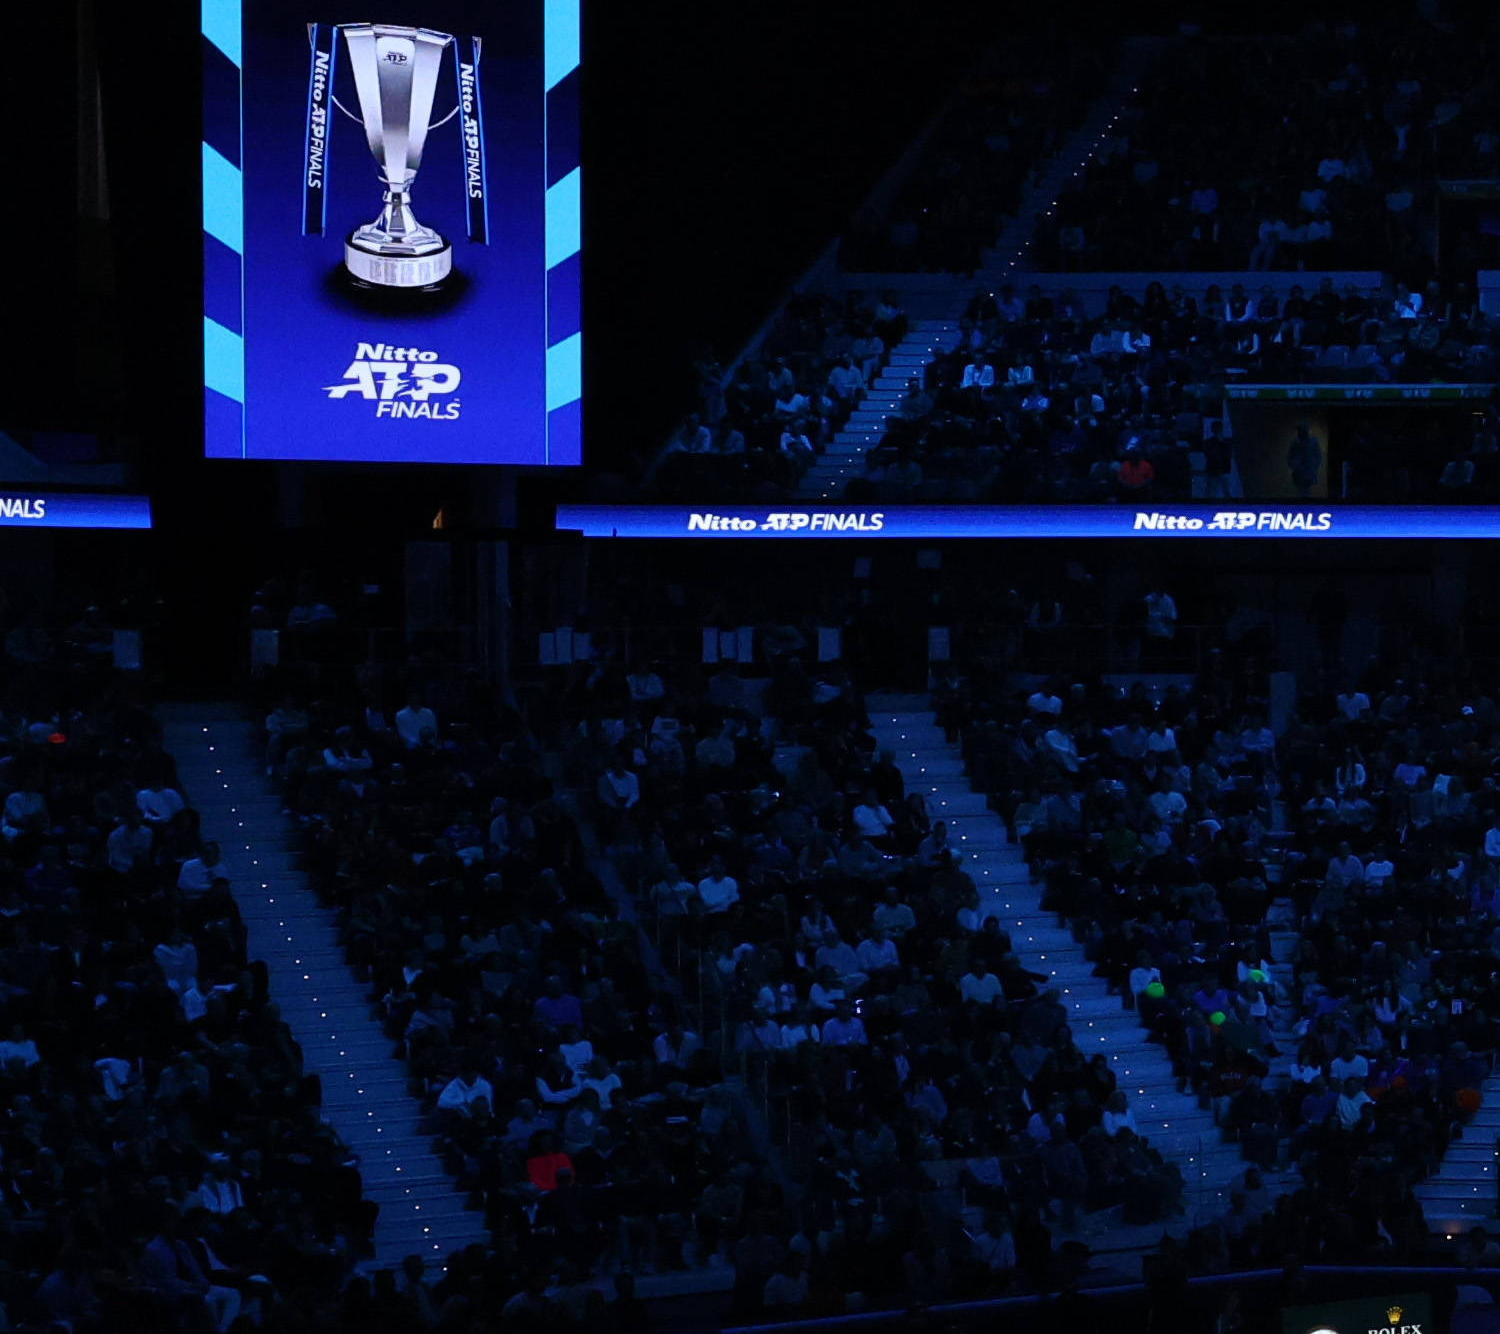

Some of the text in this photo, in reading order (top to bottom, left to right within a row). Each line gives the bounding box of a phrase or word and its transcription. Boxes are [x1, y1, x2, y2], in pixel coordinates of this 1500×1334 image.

[308, 50, 330, 189] Nitto ATP FINALS
[460, 62, 482, 199] Nitto ATP FINALS
[355, 342, 439, 362] Nitto
[321, 361, 461, 401] ATP
[376, 401, 461, 420] FINALS
[0, 498, 46, 519] NALS
[687, 513, 884, 531] Nitto ATP FINALS
[1133, 512, 1332, 531] Nitto ATP FINALS
